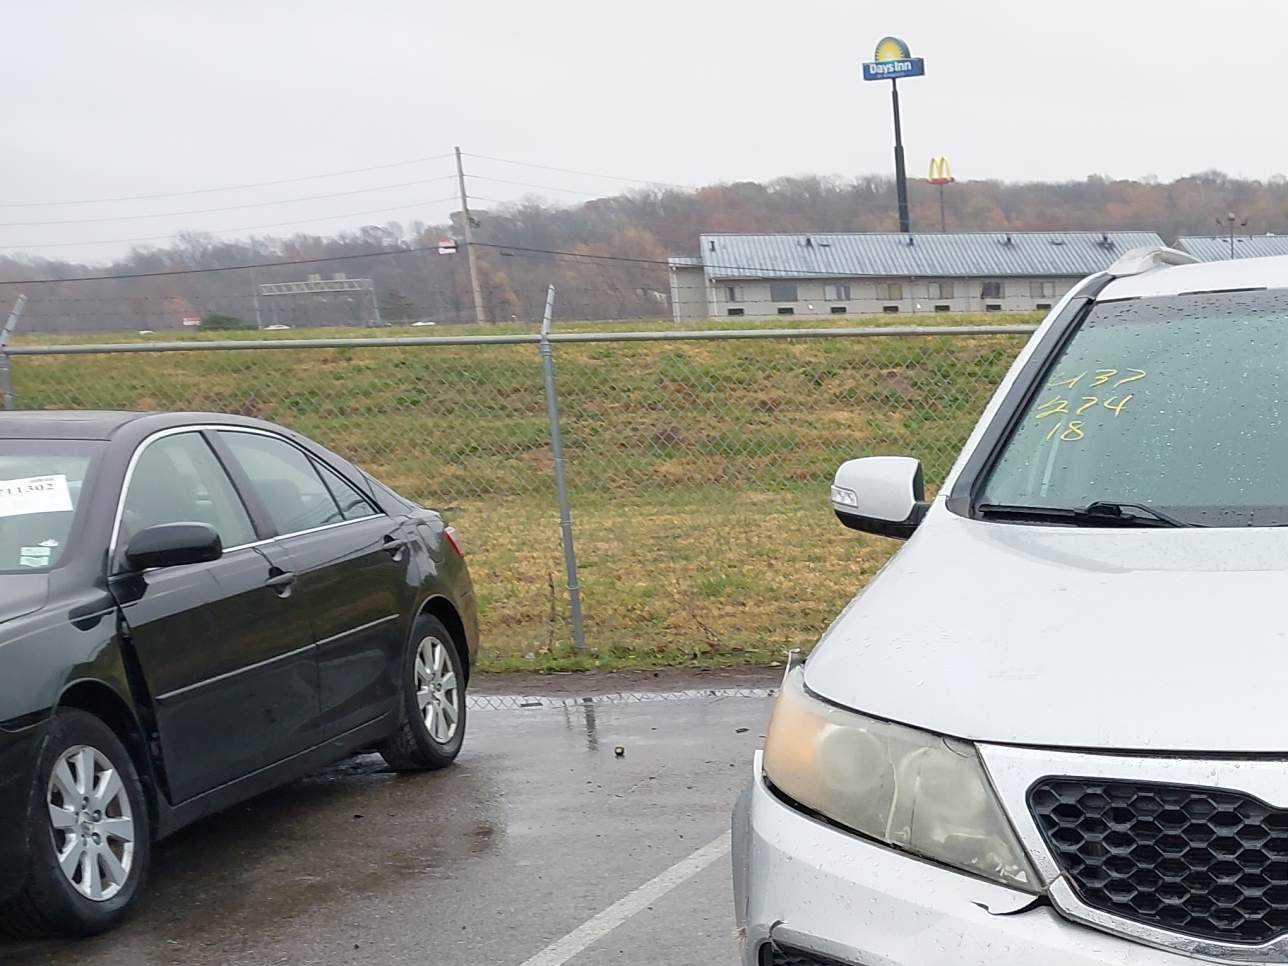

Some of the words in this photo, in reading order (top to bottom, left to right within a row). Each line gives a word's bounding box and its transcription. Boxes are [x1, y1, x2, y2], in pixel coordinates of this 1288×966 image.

[869, 63, 894, 74] Days
[894, 61, 912, 71] Inn
[1046, 420, 1085, 441] 18
